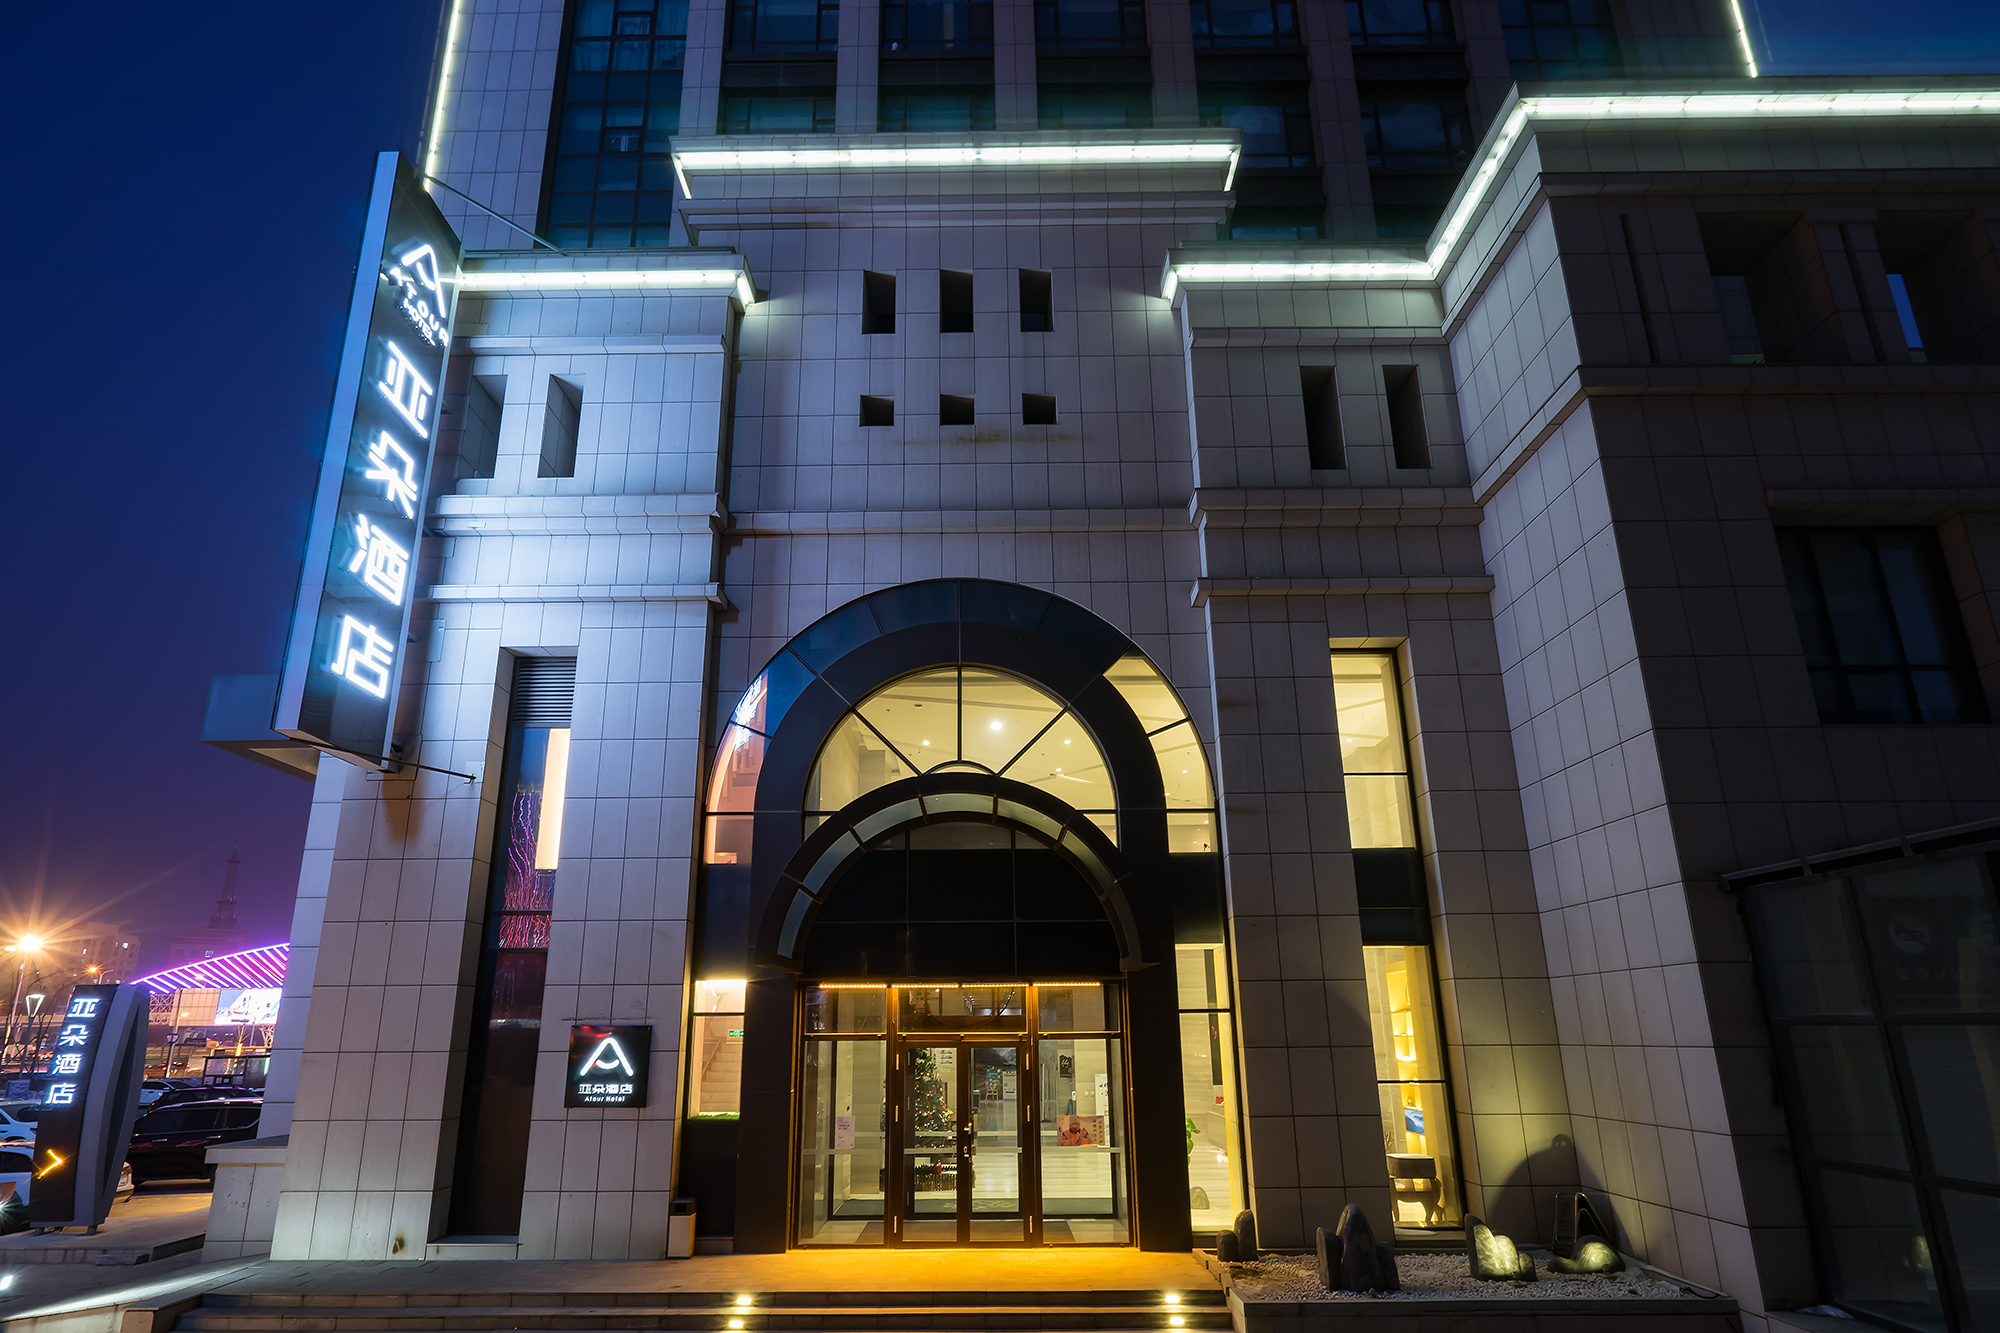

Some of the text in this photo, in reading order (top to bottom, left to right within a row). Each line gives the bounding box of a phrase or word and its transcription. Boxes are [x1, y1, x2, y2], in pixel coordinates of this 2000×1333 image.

[331, 340, 433, 699] 亚朵酒店
[45, 997, 101, 1105] 亚朵酒店
[578, 1083, 634, 1095] 亚朵酒店
[605, 1095, 626, 1103] Hotel
